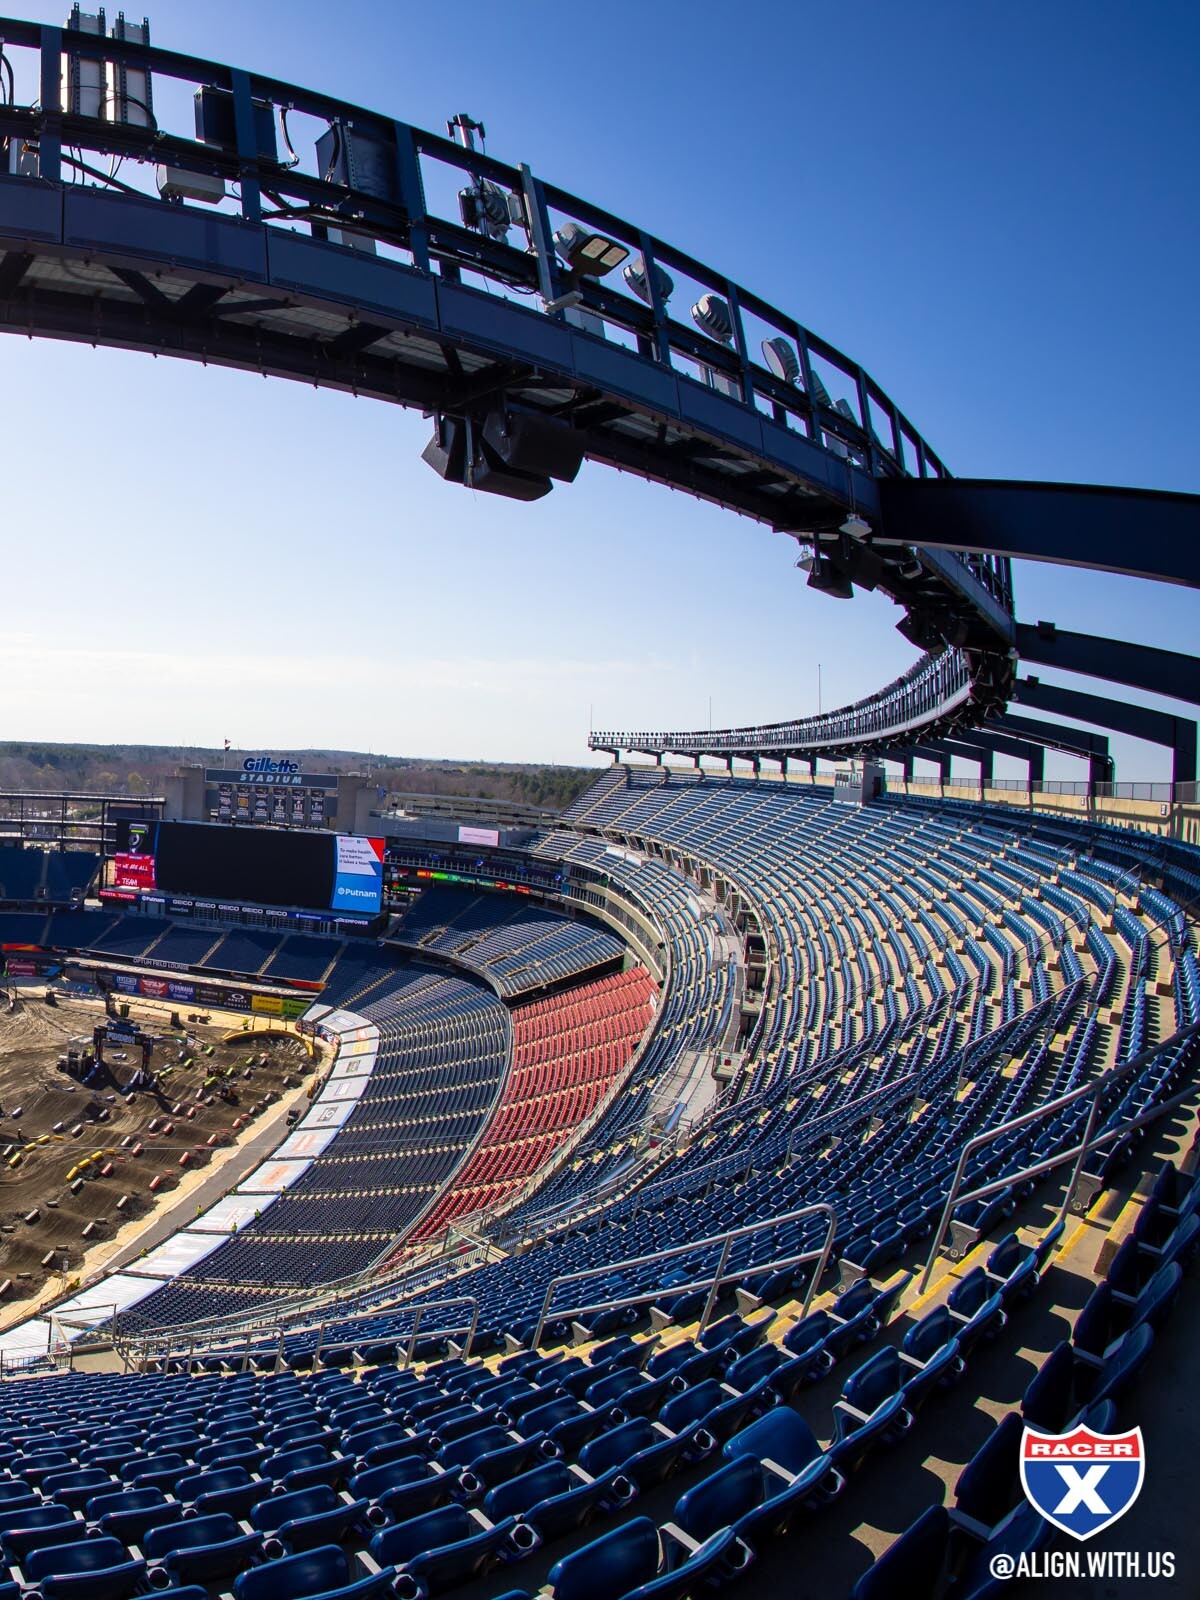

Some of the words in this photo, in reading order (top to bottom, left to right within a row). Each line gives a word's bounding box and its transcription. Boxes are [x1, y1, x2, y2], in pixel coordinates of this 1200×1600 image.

[243, 757, 299, 773] Gillette
[240, 773, 302, 784] STADIUM
[122, 877, 138, 886] TEAM
[345, 888, 377, 898] Putnam
[168, 962, 189, 970] LOUNGE
[174, 984, 194, 993] YAMAHA
